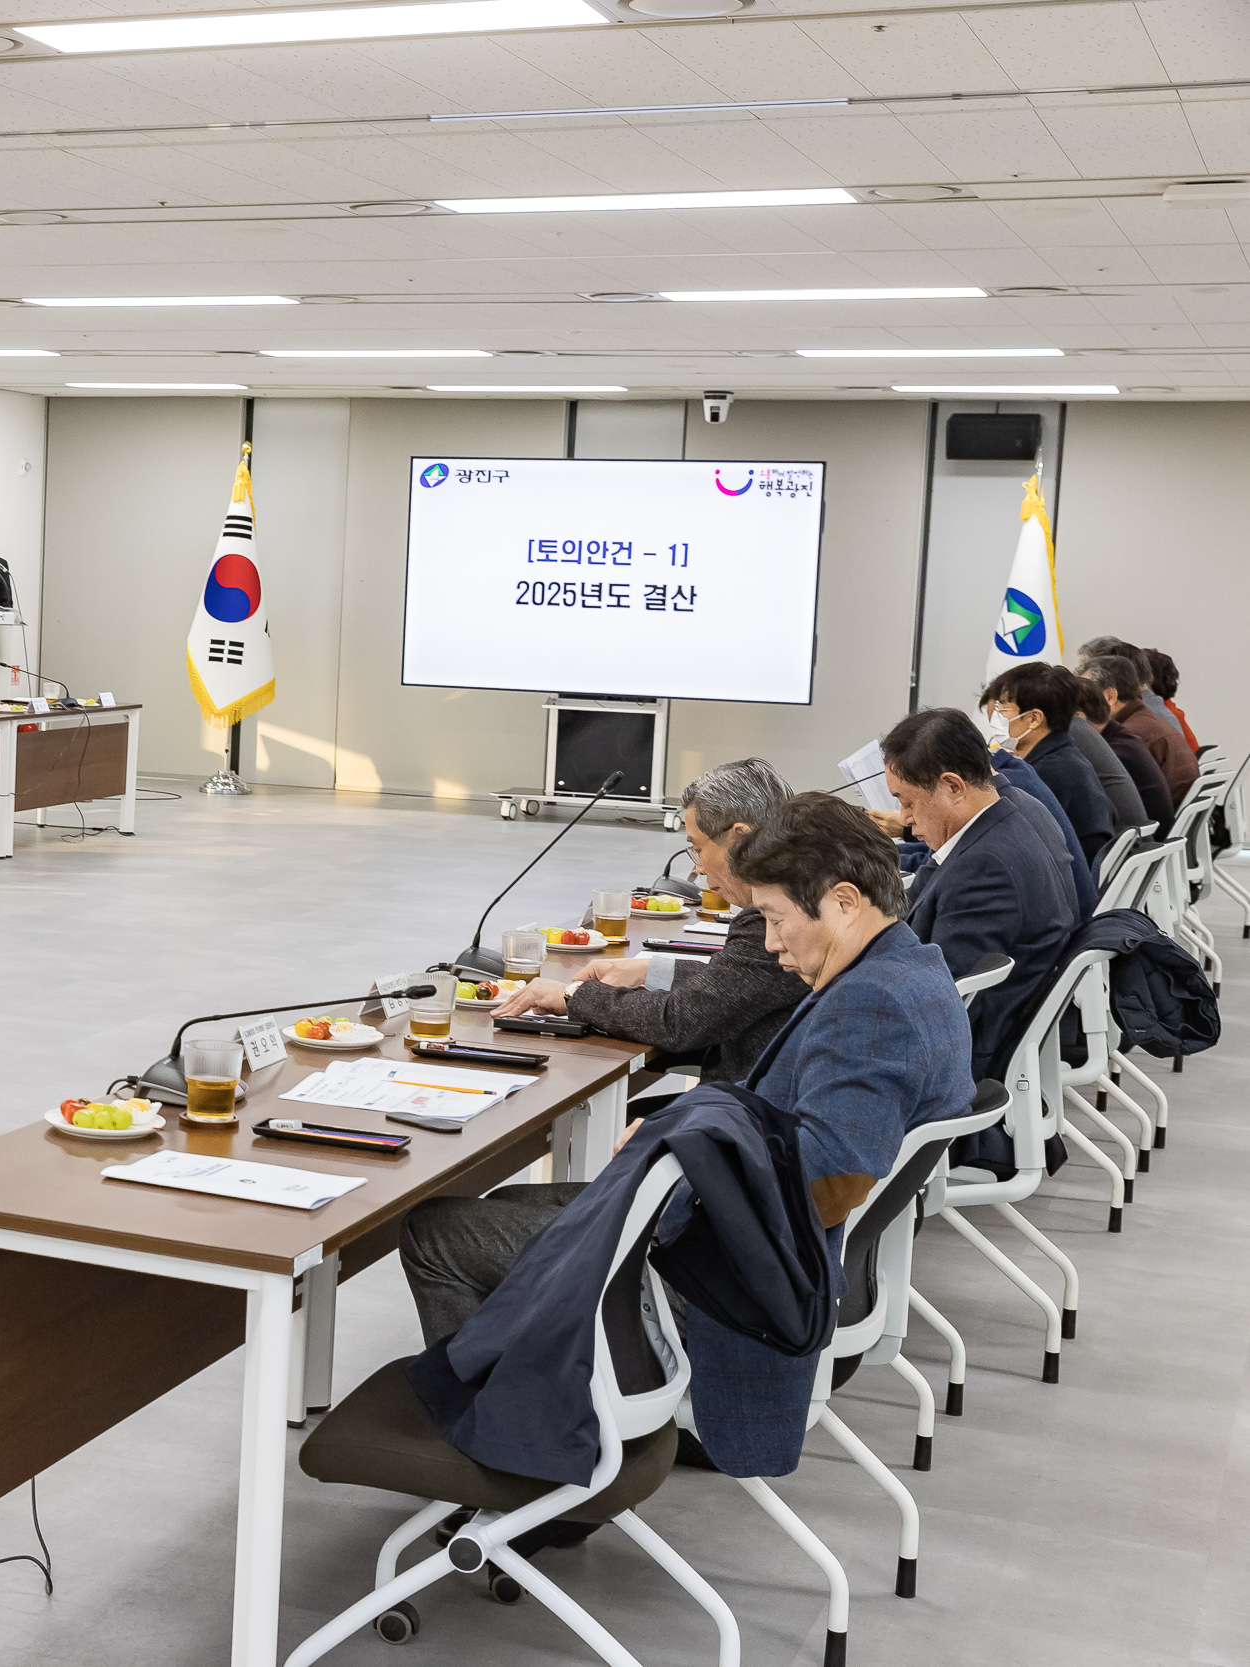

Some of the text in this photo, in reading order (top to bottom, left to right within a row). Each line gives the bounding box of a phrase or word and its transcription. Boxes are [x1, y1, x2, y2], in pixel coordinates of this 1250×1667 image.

[455, 469, 510, 484] 광진구
[758, 479, 814, 499] 행복광진
[527, 539, 633, 566] [토의안건
[668, 543, 689, 568] 1]
[515, 580, 698, 612] 2025년도 결산
